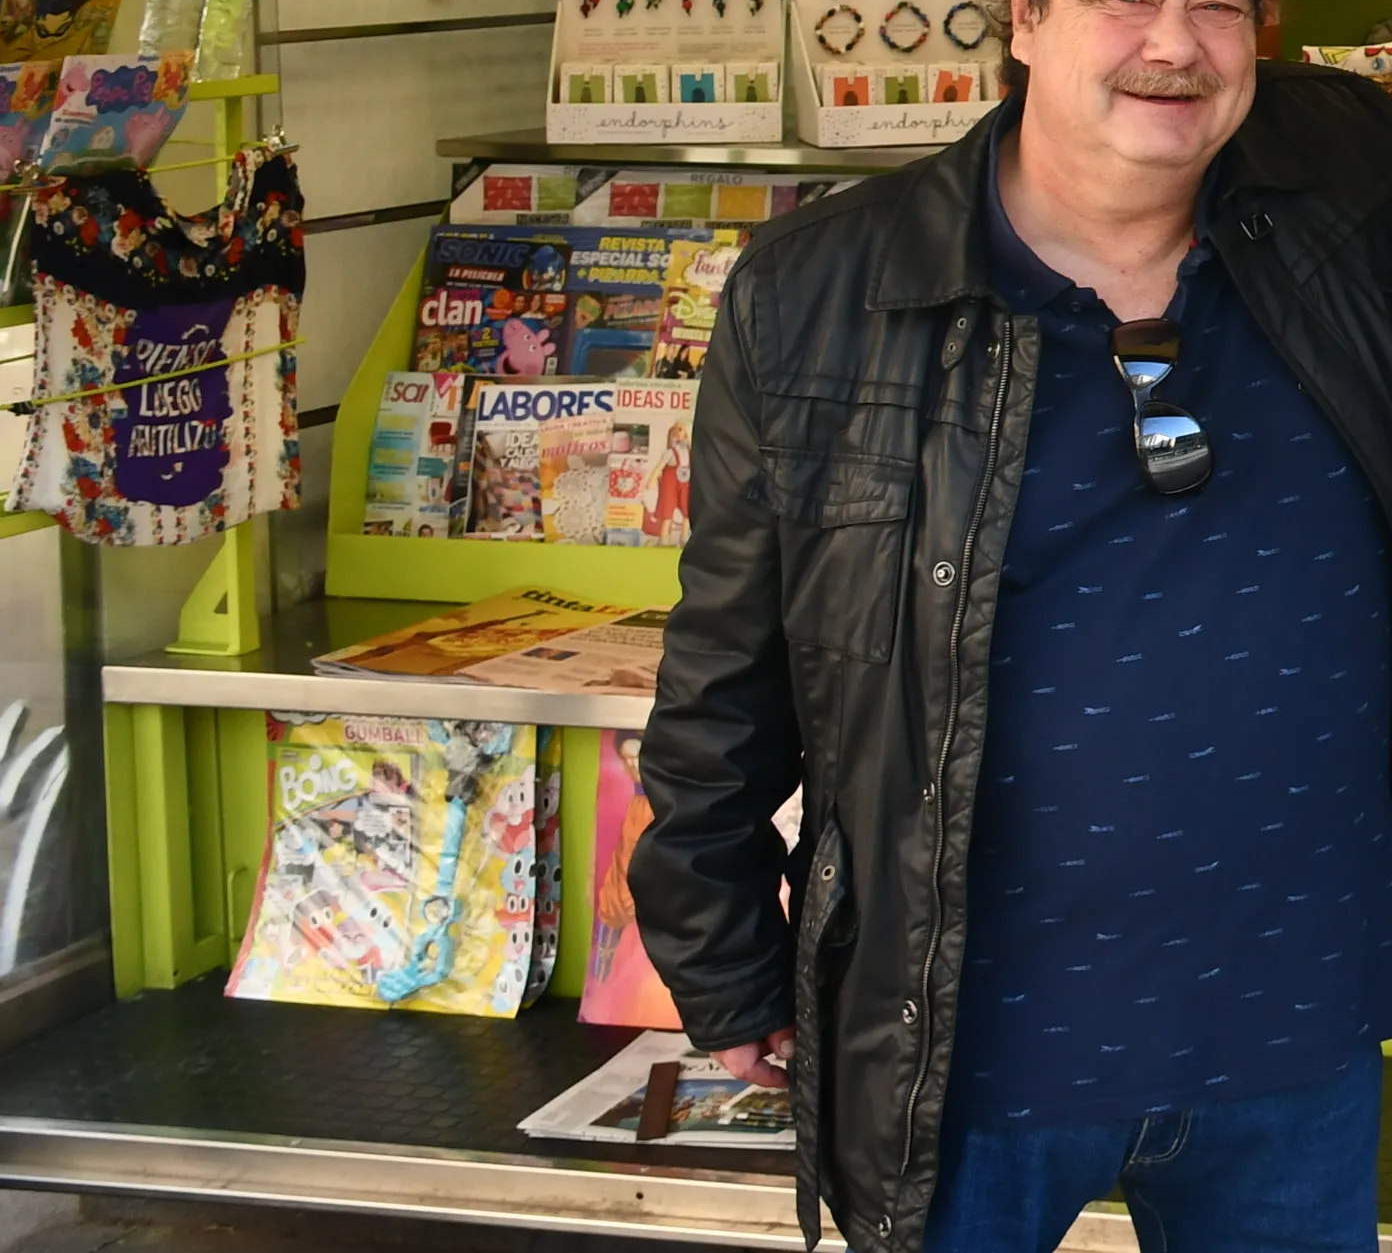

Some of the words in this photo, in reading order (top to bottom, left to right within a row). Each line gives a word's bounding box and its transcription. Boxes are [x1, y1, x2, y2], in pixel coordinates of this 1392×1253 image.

[596, 106, 737, 133] endorphins
[690, 173, 744, 186] REGALO
[599, 236, 666, 250] REVISTA
[570, 251, 645, 267] ESPECIAL
[422, 293, 483, 327] clan
[139, 379, 202, 418] LUEGO
[477, 389, 614, 422] LABORES
[616, 389, 665, 410] IDEAS
[670, 391, 691, 410] DE
[344, 723, 424, 744] GUMBALL
